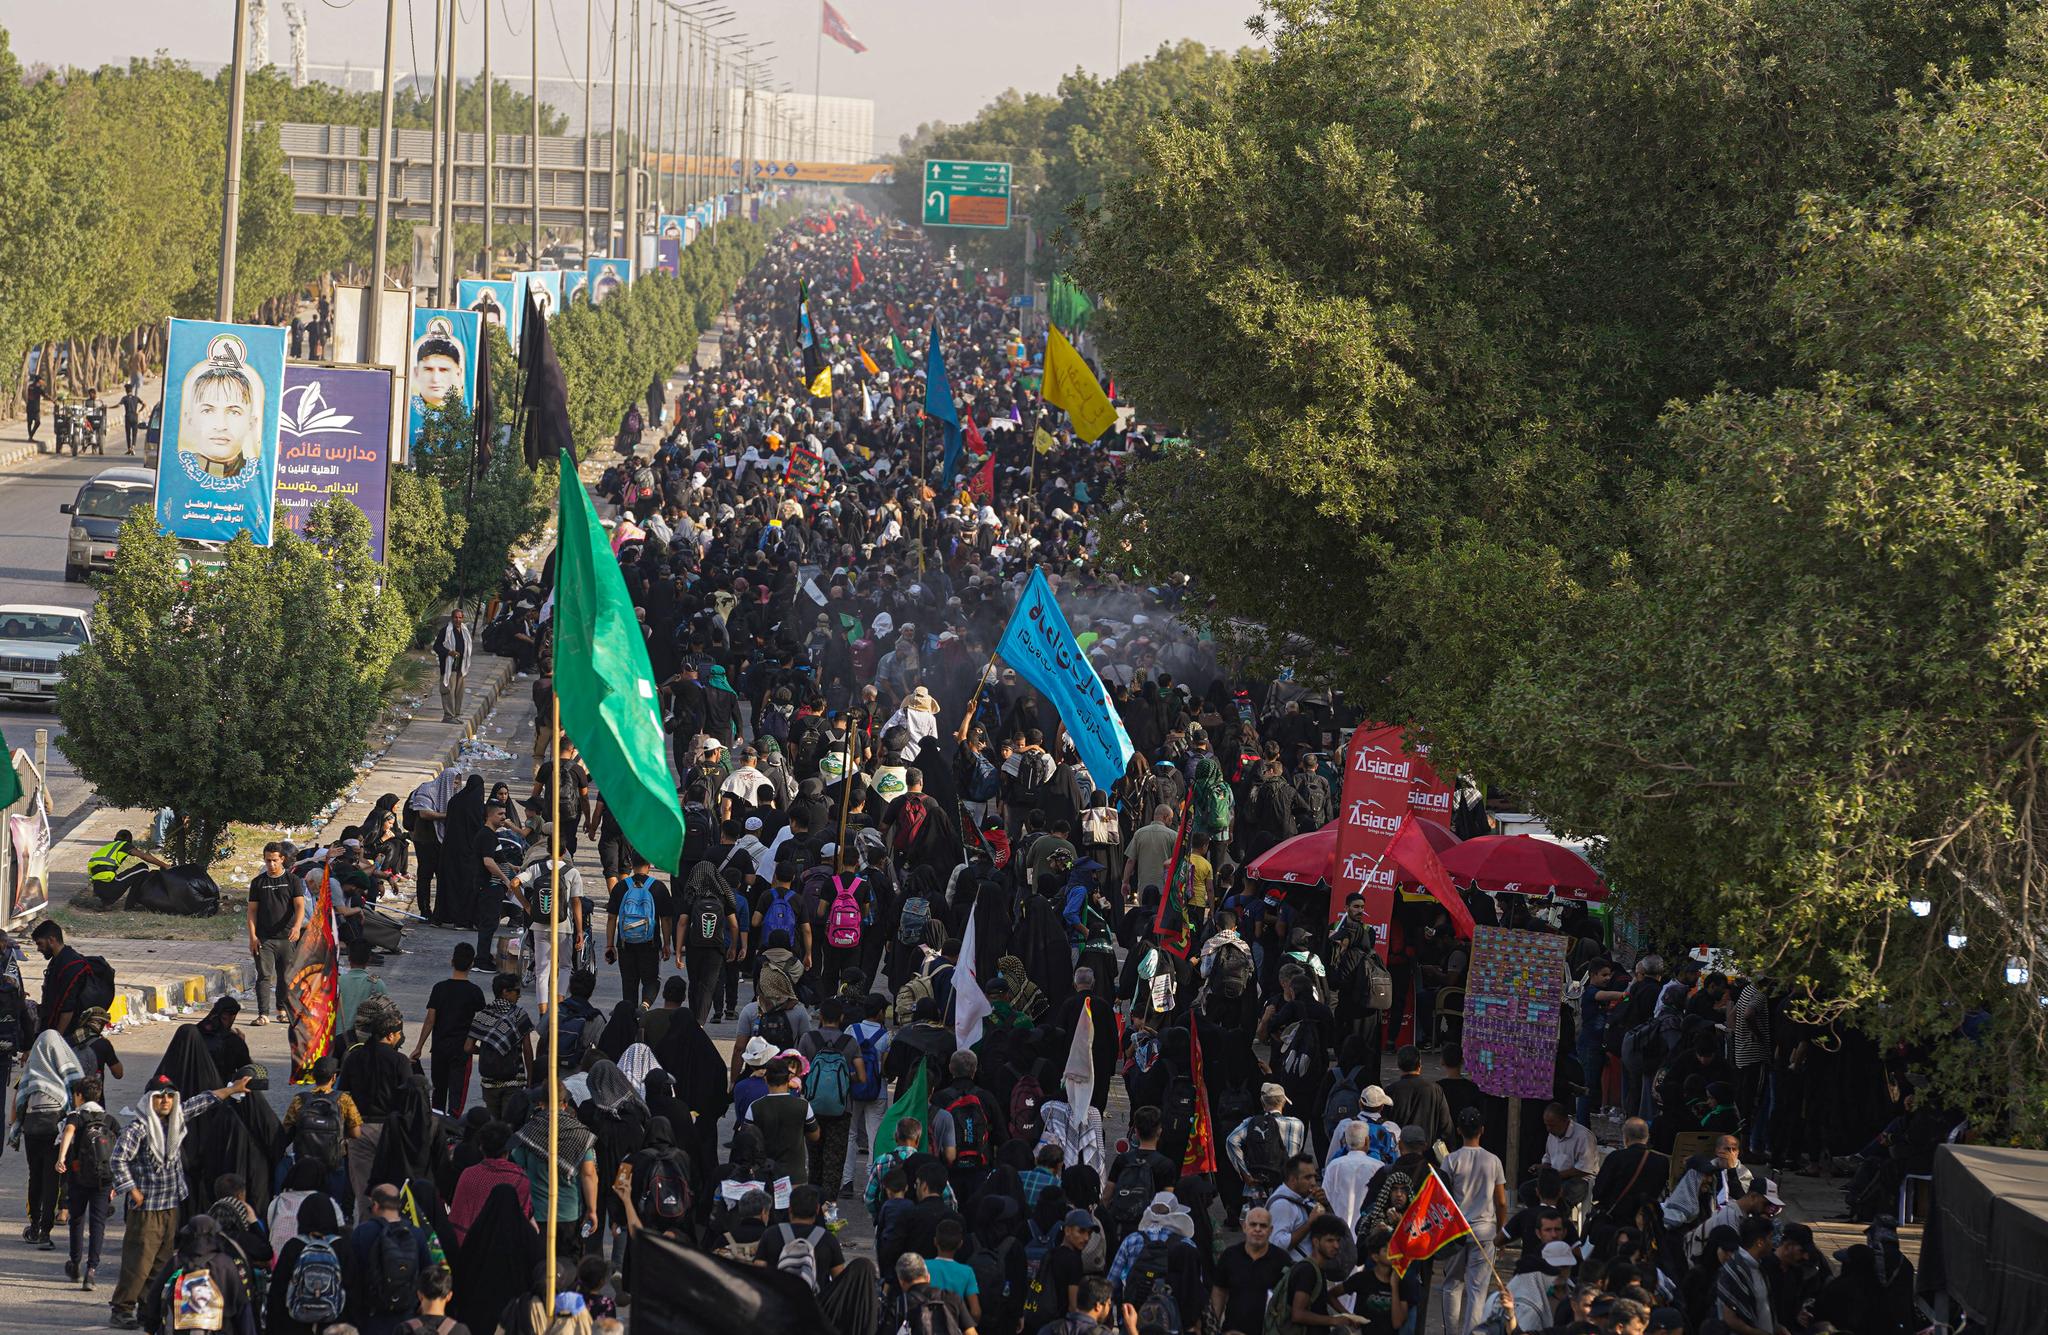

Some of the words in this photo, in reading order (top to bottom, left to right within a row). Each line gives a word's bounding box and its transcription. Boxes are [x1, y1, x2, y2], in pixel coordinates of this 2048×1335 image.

[286, 442, 322, 460] قائم
[325, 445, 378, 463] مدارس
[287, 464, 310, 475] للبنين
[1355, 751, 1410, 778] Asiacell
[1407, 788, 1450, 808] siacell
[1349, 804, 1402, 832] Asiacell
